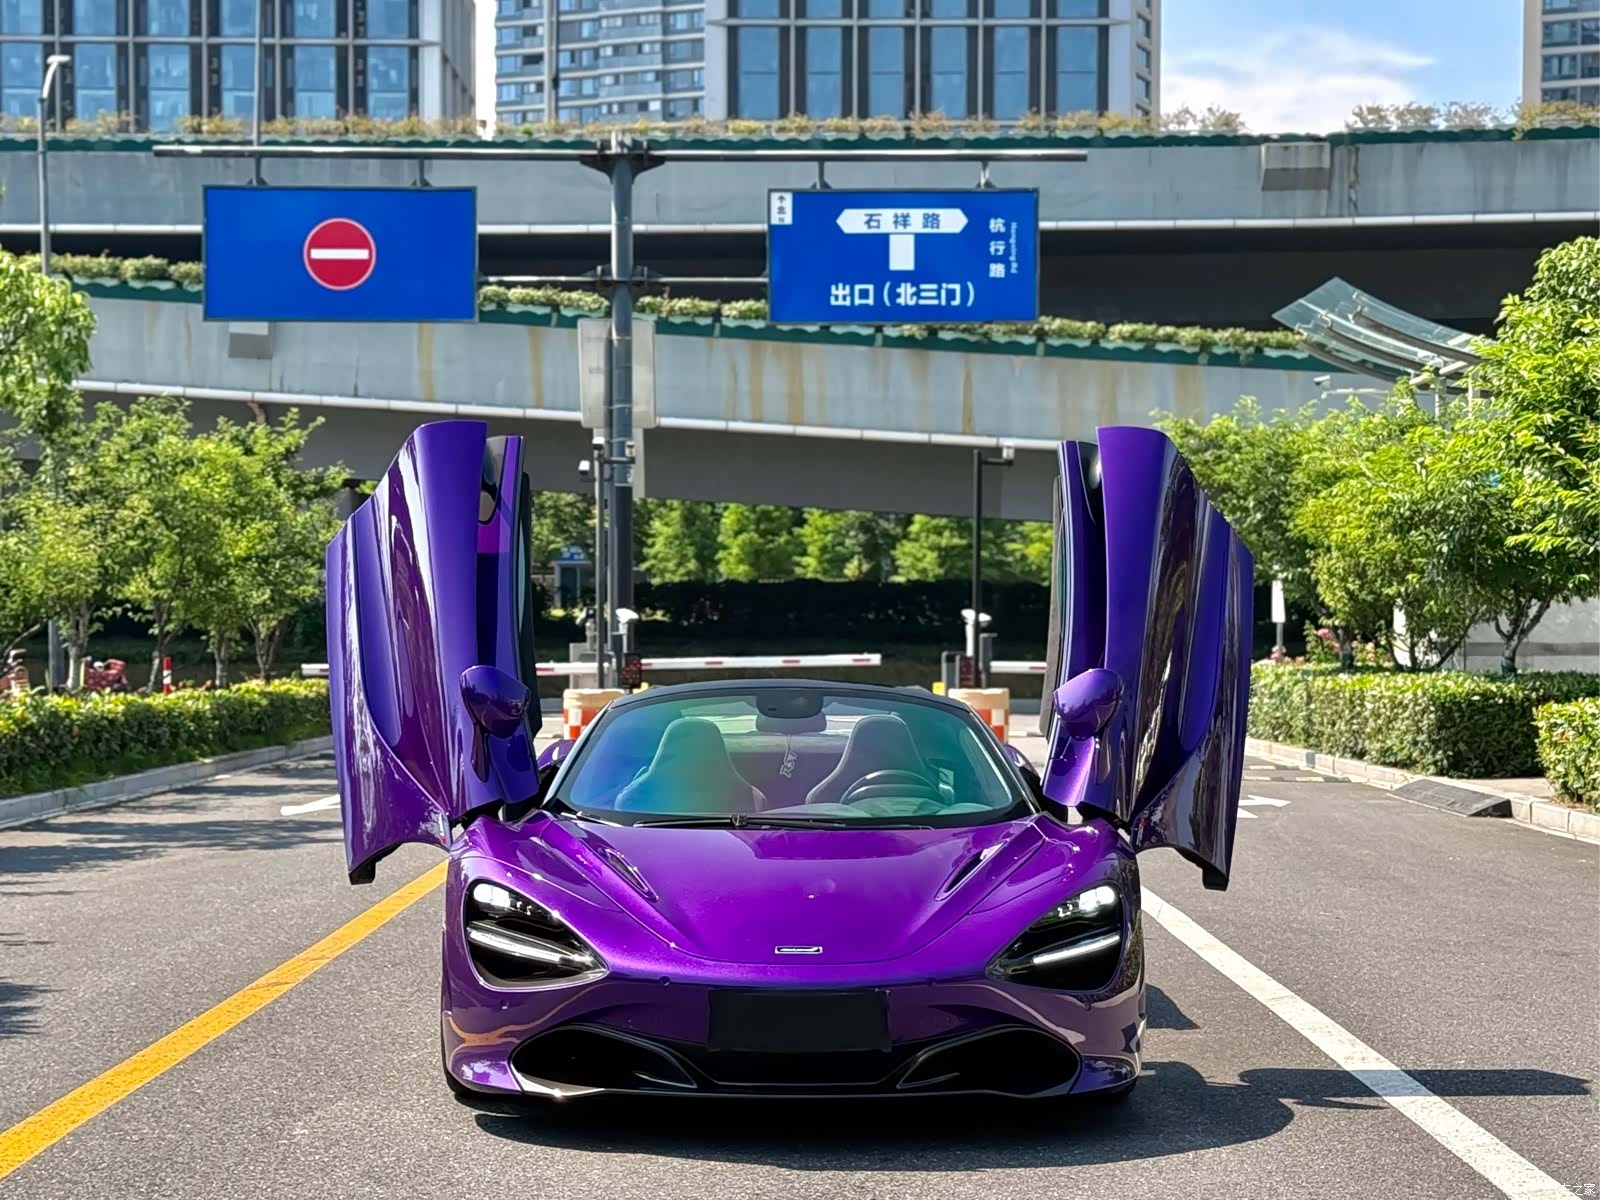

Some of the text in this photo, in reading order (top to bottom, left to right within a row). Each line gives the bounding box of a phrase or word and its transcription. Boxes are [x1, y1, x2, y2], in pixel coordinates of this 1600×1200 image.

[864, 212, 941, 230] 石祥路
[989, 217, 1006, 278] 杭行路
